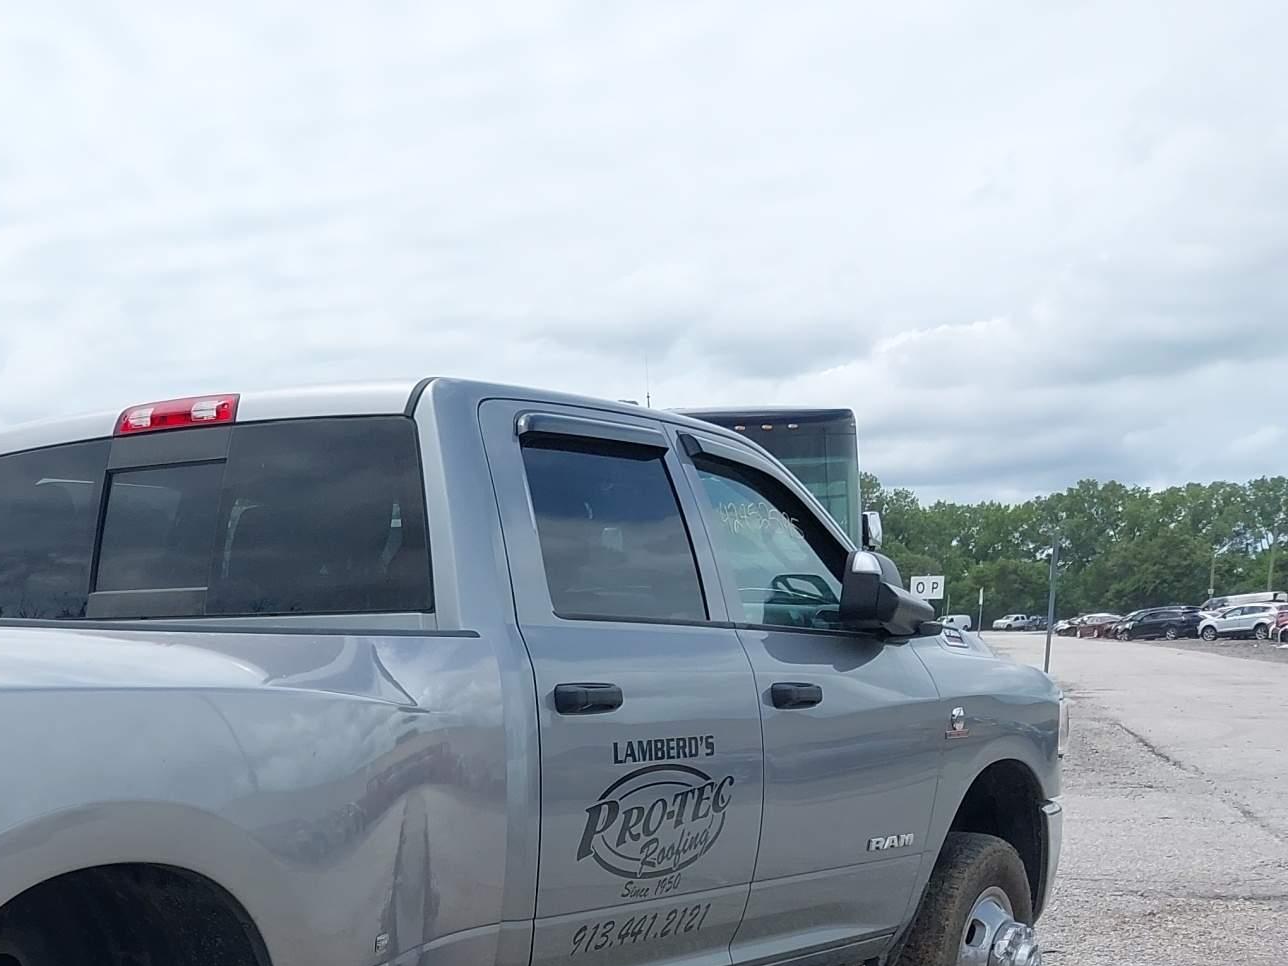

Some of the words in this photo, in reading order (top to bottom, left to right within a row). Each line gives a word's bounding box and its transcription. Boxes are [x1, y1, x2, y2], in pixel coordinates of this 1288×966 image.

[612, 735, 715, 765] LAMBERD'S
[576, 775, 735, 862] PRO-TEC
[637, 828, 710, 878] Roofing
[867, 833, 914, 852] RAM
[620, 880, 650, 898] Since
[654, 873, 682, 896] 1950
[570, 903, 713, 957] 913.441.2121
